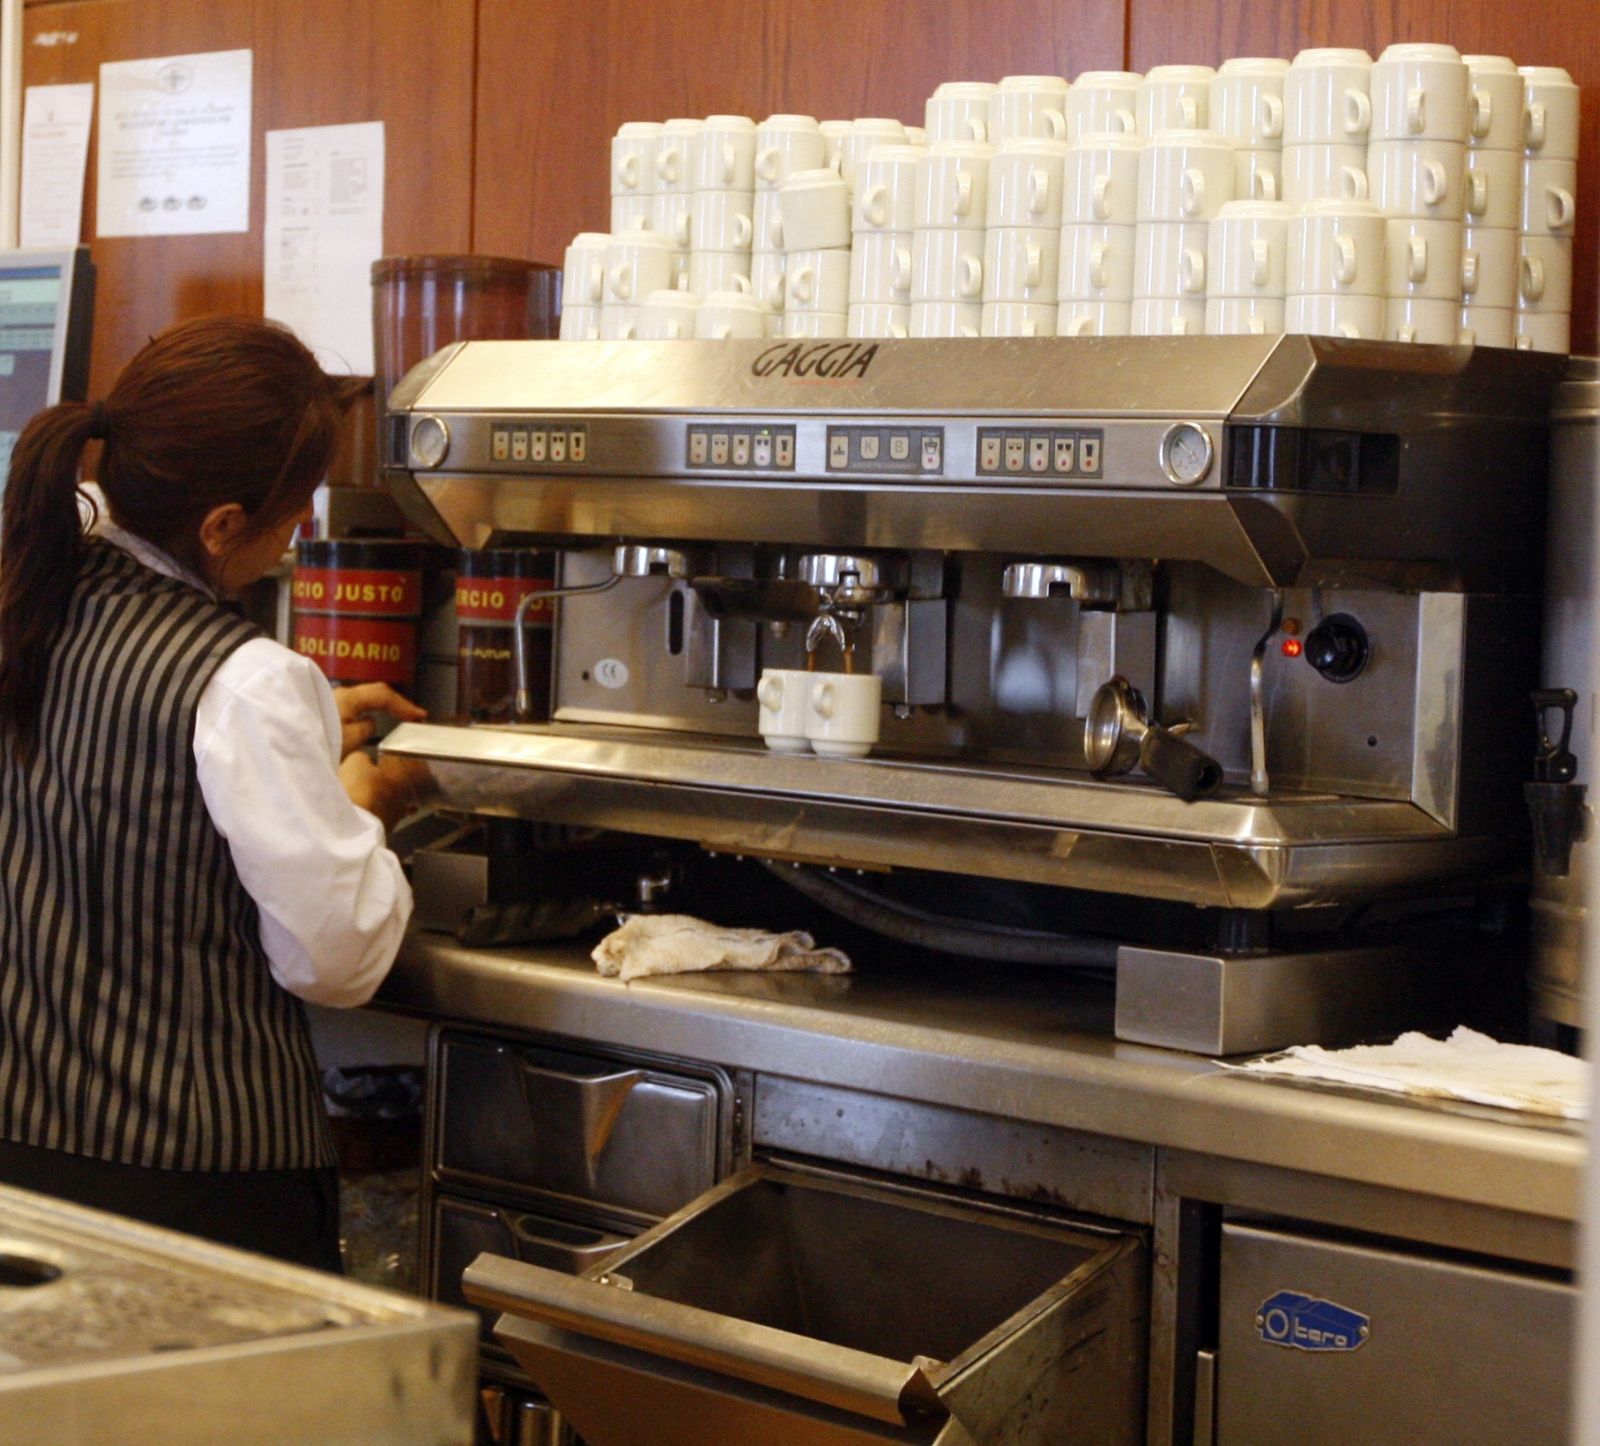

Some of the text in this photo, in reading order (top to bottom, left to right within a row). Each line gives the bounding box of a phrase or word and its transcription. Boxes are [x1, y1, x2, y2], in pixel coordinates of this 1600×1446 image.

[752, 343, 880, 378] GAGGIA
[335, 583, 403, 602] JUSTO
[299, 636, 400, 662] SOLIDARIO
